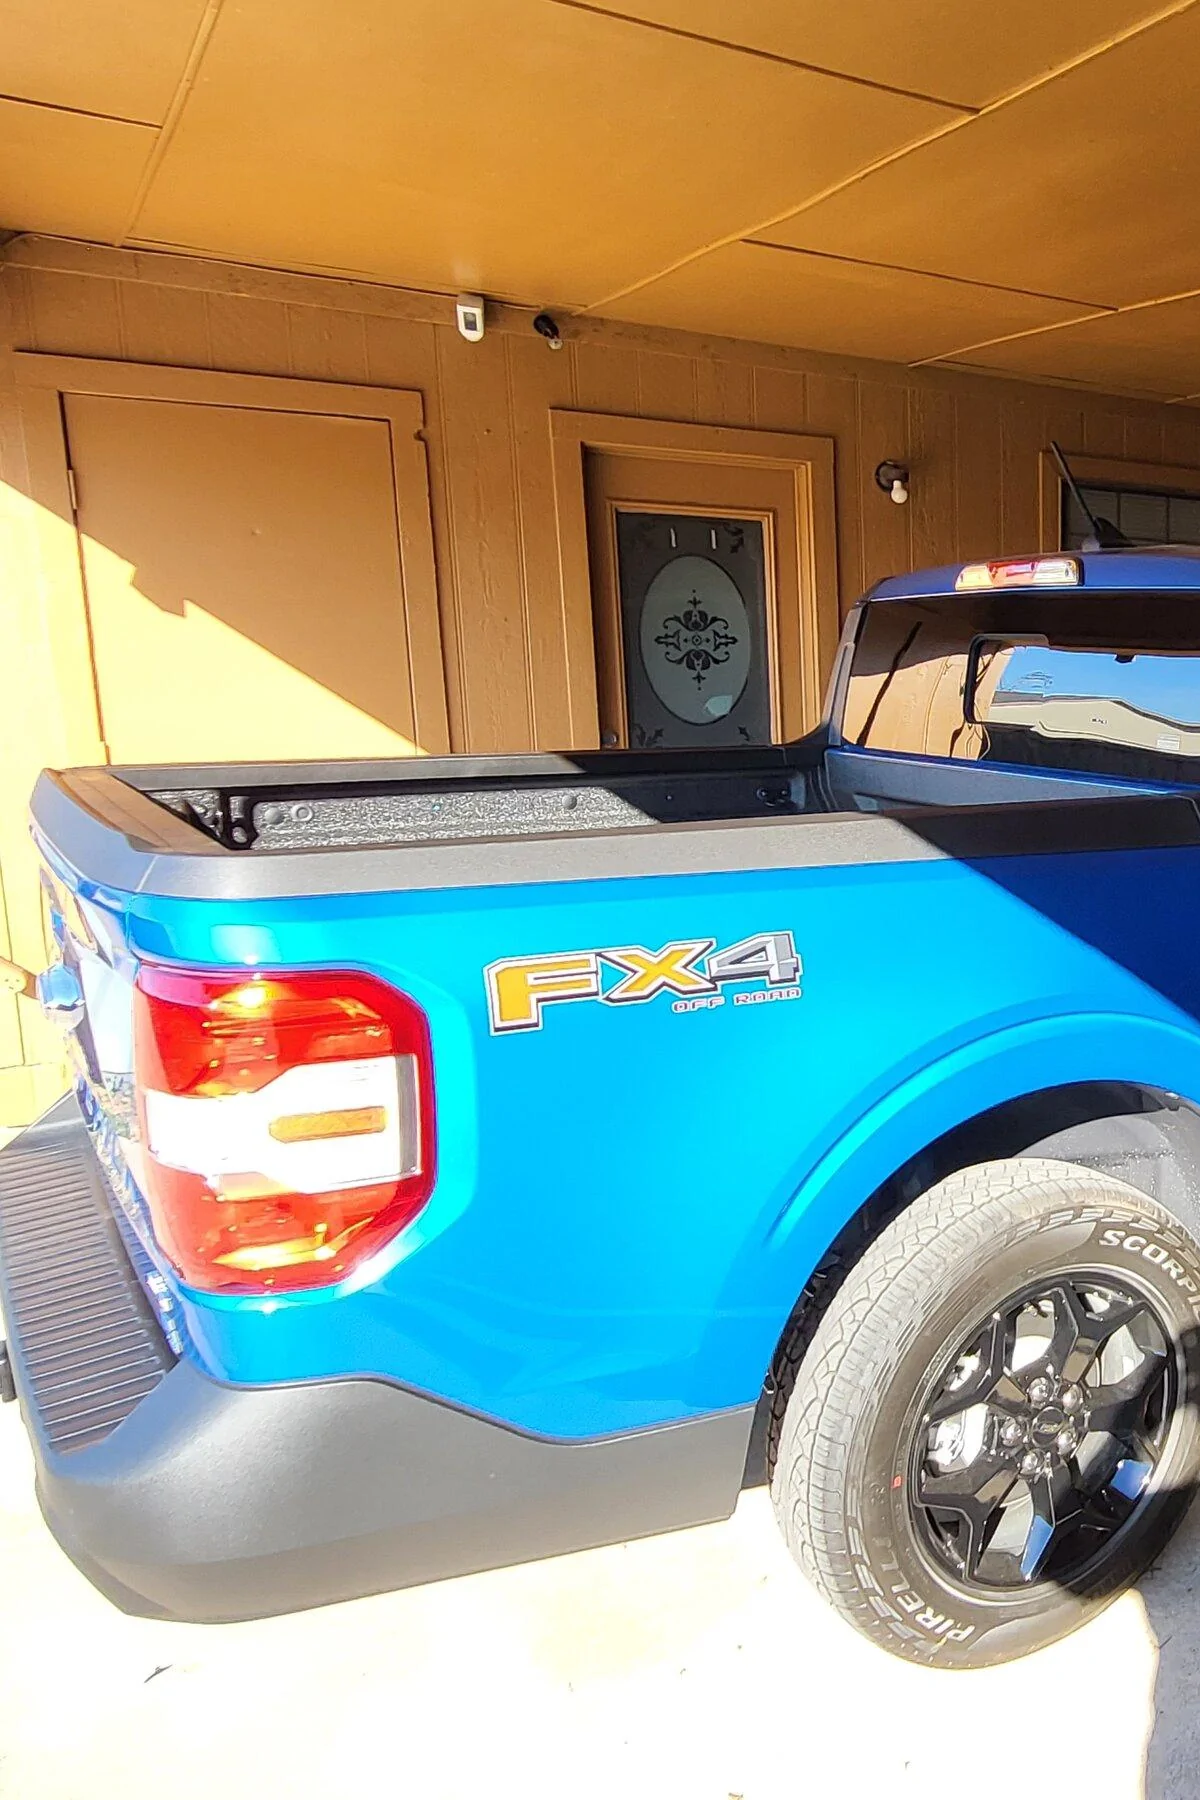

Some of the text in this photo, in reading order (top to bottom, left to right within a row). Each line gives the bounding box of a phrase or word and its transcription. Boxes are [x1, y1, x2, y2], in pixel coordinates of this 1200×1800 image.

[482, 931, 802, 1034] FX4
[673, 987, 802, 1013] OFF ROAD
